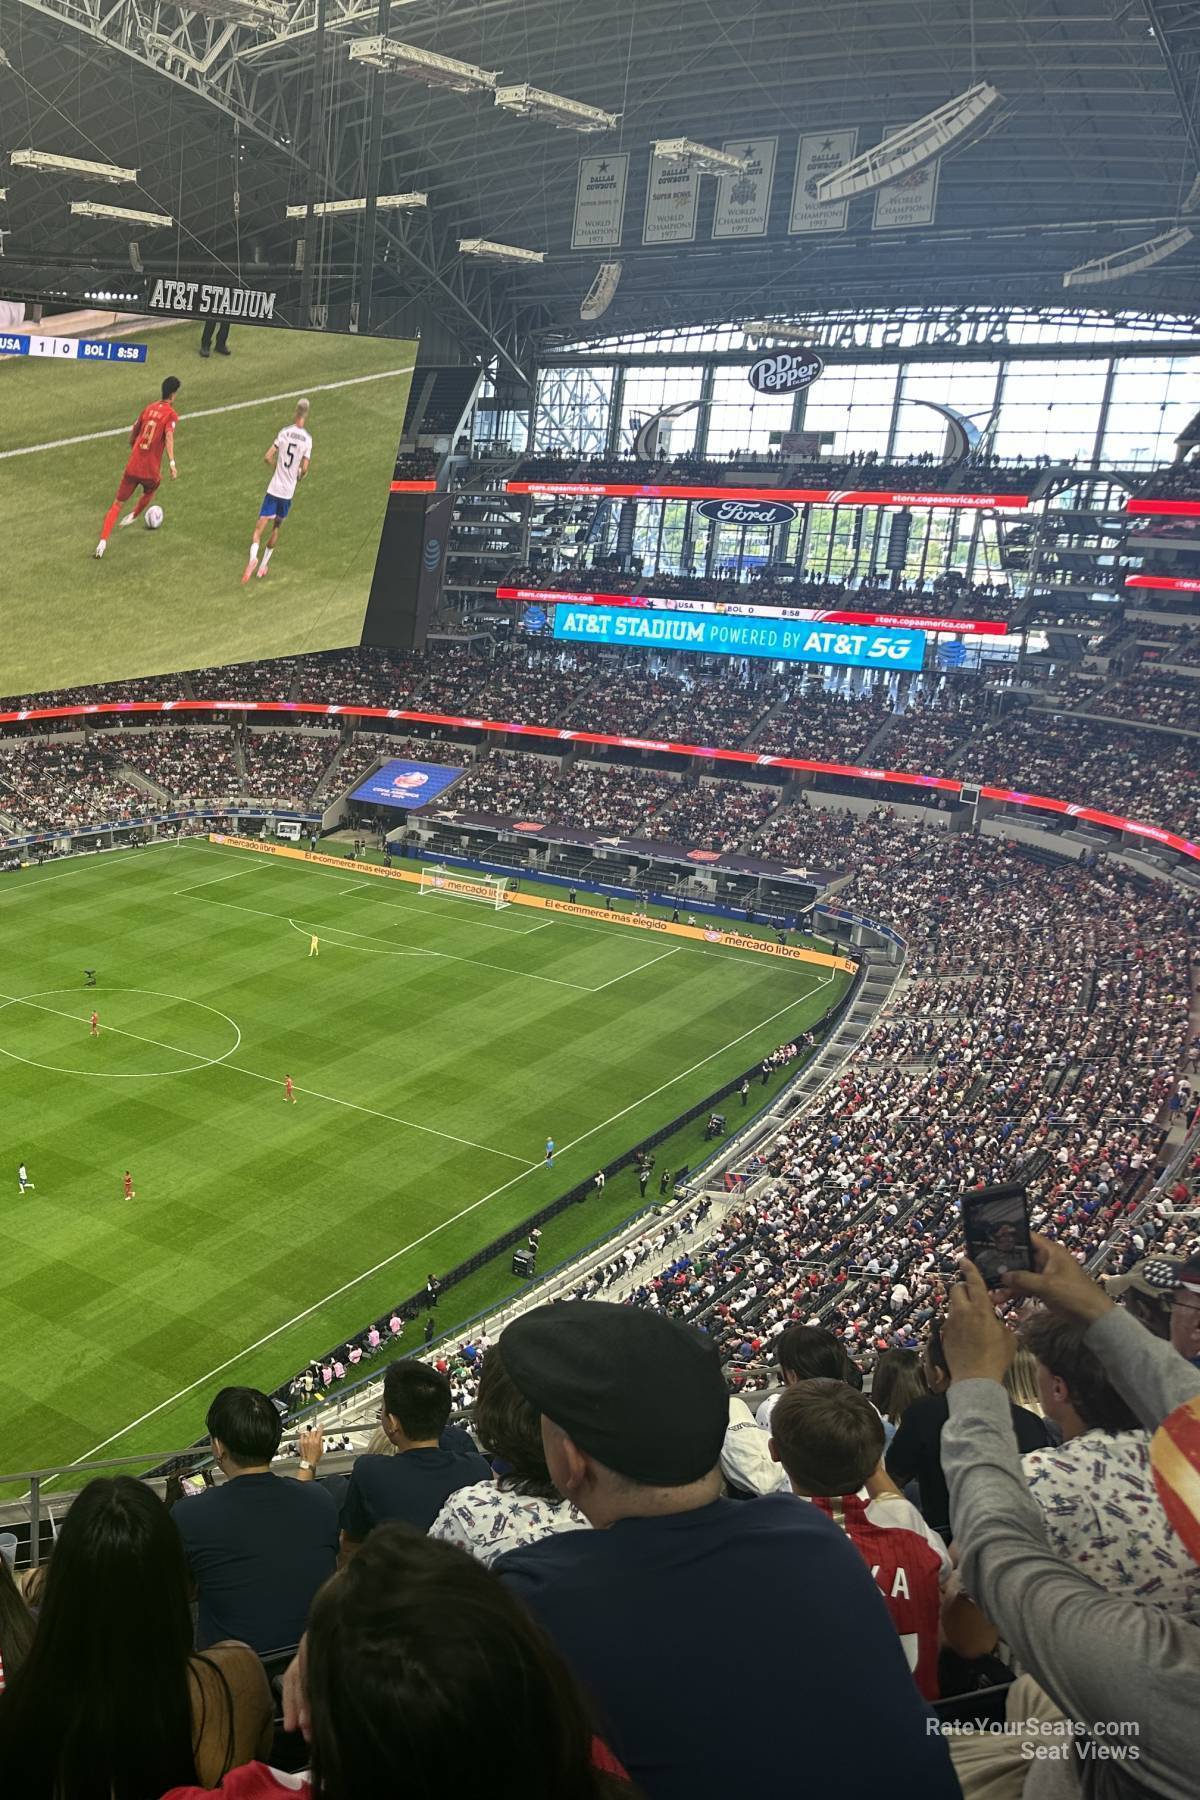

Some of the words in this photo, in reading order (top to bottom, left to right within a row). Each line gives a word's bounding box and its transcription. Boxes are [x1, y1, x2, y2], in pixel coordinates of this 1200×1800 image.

[812, 153, 841, 162] DALLAS
[590, 175, 615, 183] DALLAS
[658, 175, 690, 184] COWBOYS
[661, 168, 688, 176] DALLAS
[586, 182, 617, 191] COWBOYS
[794, 210, 843, 220] CHAMPIONS
[879, 205, 930, 215] CHAMPIONS
[648, 222, 692, 231] CHAMPIONS
[718, 215, 764, 225] CHAMPIONS
[576, 228, 618, 236] CHAMPIONS
[150, 278, 198, 311] AT&T
[200, 284, 277, 319] STADIUM
[0, 338, 21, 350] USA
[39, 341, 45, 352] 1
[62, 344, 70, 355] 0
[84, 344, 104, 356] BOL
[118, 347, 138, 359] 8:58
[776, 354, 802, 373] Dr
[750, 359, 818, 389] Pepper
[284, 443, 297, 468] 5
[528, 484, 606, 494] store.copaamerica.com
[892, 494, 996, 505] store.copaamerica.com
[717, 501, 777, 523] Ford
[517, 589, 594, 602] store.copaamerica.com
[678, 602, 694, 610] USA
[728, 605, 743, 613] BOL
[782, 609, 800, 617] 8:58
[875, 615, 976, 630] store.copaamerica.com
[563, 612, 611, 634] AT&T
[615, 616, 704, 642] STADIUM
[710, 625, 777, 648] POWERED
[784, 631, 800, 649] BY
[803, 632, 867, 655] AT&T
[868, 638, 912, 659] 5G
[227, 837, 259, 850] mercado
[259, 844, 276, 854] libre
[304, 852, 311, 860] El
[312, 854, 356, 869] e-commerce
[374, 866, 402, 878] elegido
[447, 881, 487, 896] mercado
[545, 899, 554, 907] El
[555, 902, 610, 919] e-commerce
[632, 917, 668, 931] elegido
[724, 935, 774, 955] mercado
[775, 942, 801, 959] libre
